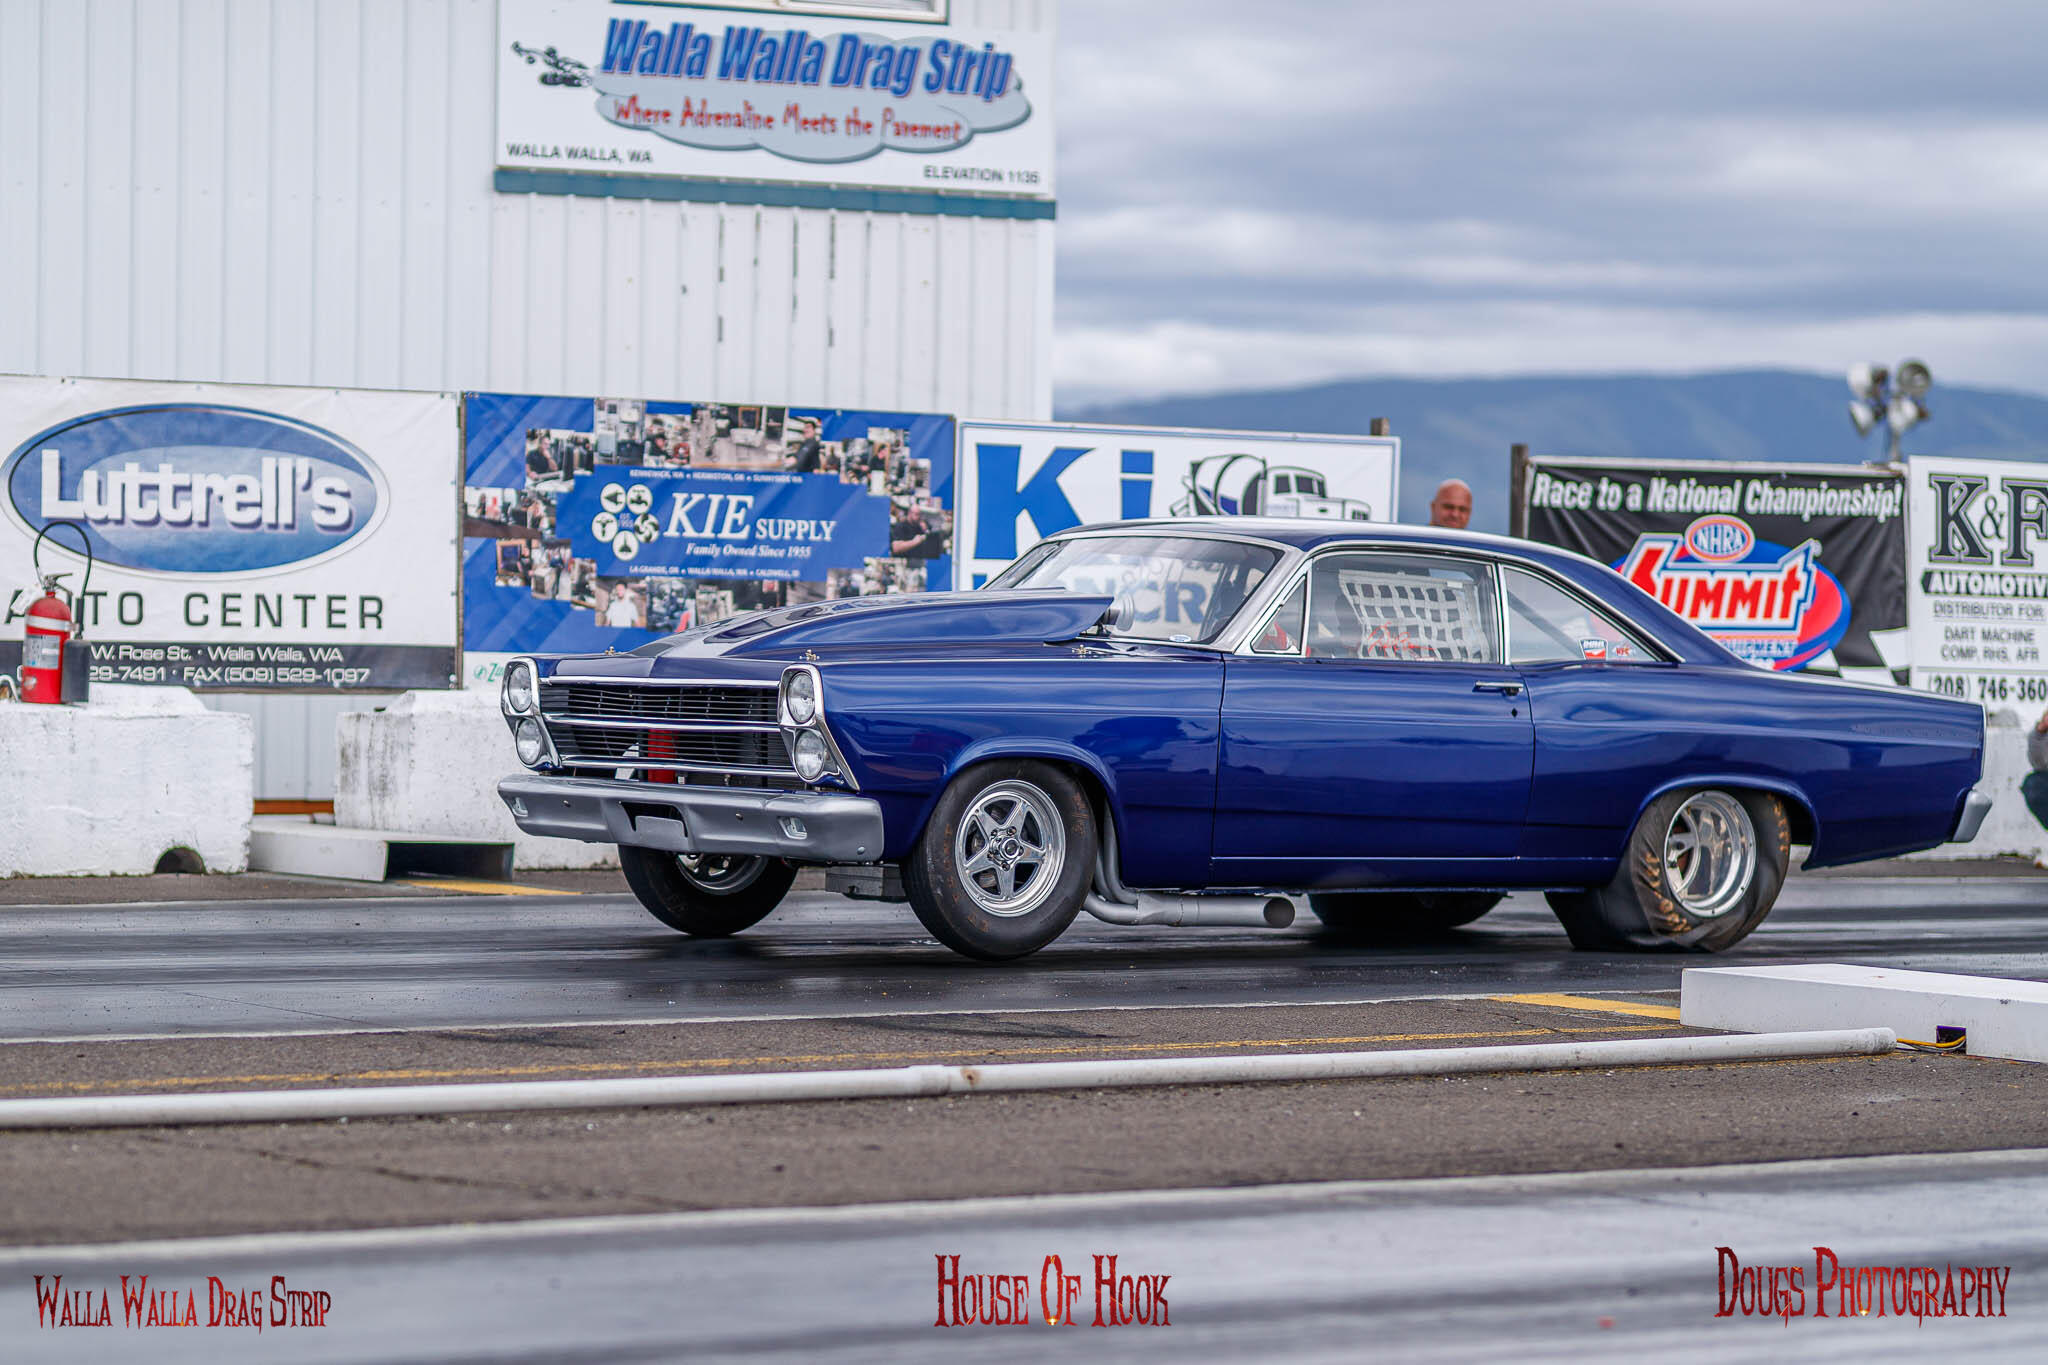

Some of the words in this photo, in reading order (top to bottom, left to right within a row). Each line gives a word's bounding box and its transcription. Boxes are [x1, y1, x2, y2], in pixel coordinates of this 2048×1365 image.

[601, 17, 712, 79] Walla
[716, 25, 826, 86] Walla
[830, 32, 921, 97] Drag
[923, 38, 1013, 102] Strip
[613, 95, 672, 125] Where
[680, 97, 774, 131] Adrenaline
[782, 103, 837, 134] Meets
[845, 107, 873, 135] the
[882, 108, 961, 143] Pavement
[506, 143, 561, 159] WALLA
[566, 145, 623, 164] WALLA,
[627, 149, 653, 163] WA
[923, 164, 1003, 182] ELEVATION
[40, 448, 352, 527] Luttrell's
[1532, 474, 1595, 511] Race
[1598, 477, 1623, 511] to
[1626, 483, 1643, 512] a
[1648, 476, 1742, 514] National
[1745, 480, 1903, 523] Championship!
[663, 492, 754, 540] KIE
[755, 518, 837, 542] SUPPLY
[1928, 473, 2048, 567] K&F
[686, 542, 721, 558] Family
[723, 544, 758, 556] Owned
[758, 544, 786, 557] Since
[787, 545, 812, 558] 1955
[1693, 523, 1746, 551] NHRA
[1928, 570, 2048, 598] AUTOMOTIV
[183, 591, 385, 630] CENTER
[1933, 600, 2012, 617] DISTRIBUTOR
[2018, 603, 2044, 619] FOR
[1944, 626, 1976, 642] DART
[1981, 628, 2036, 643] MACHINE
[90, 645, 115, 661] W.
[118, 645, 164, 661] Rose
[166, 645, 193, 661] St.
[207, 646, 255, 662] Walla
[256, 647, 306, 664] Walla,
[309, 648, 345, 663] WA
[89, 666, 167, 682] 29-7491
[183, 666, 223, 682] FAX
[224, 666, 274, 682] (509)
[277, 667, 371, 683] 529-1097
[1978, 676, 2048, 702] 746-360
